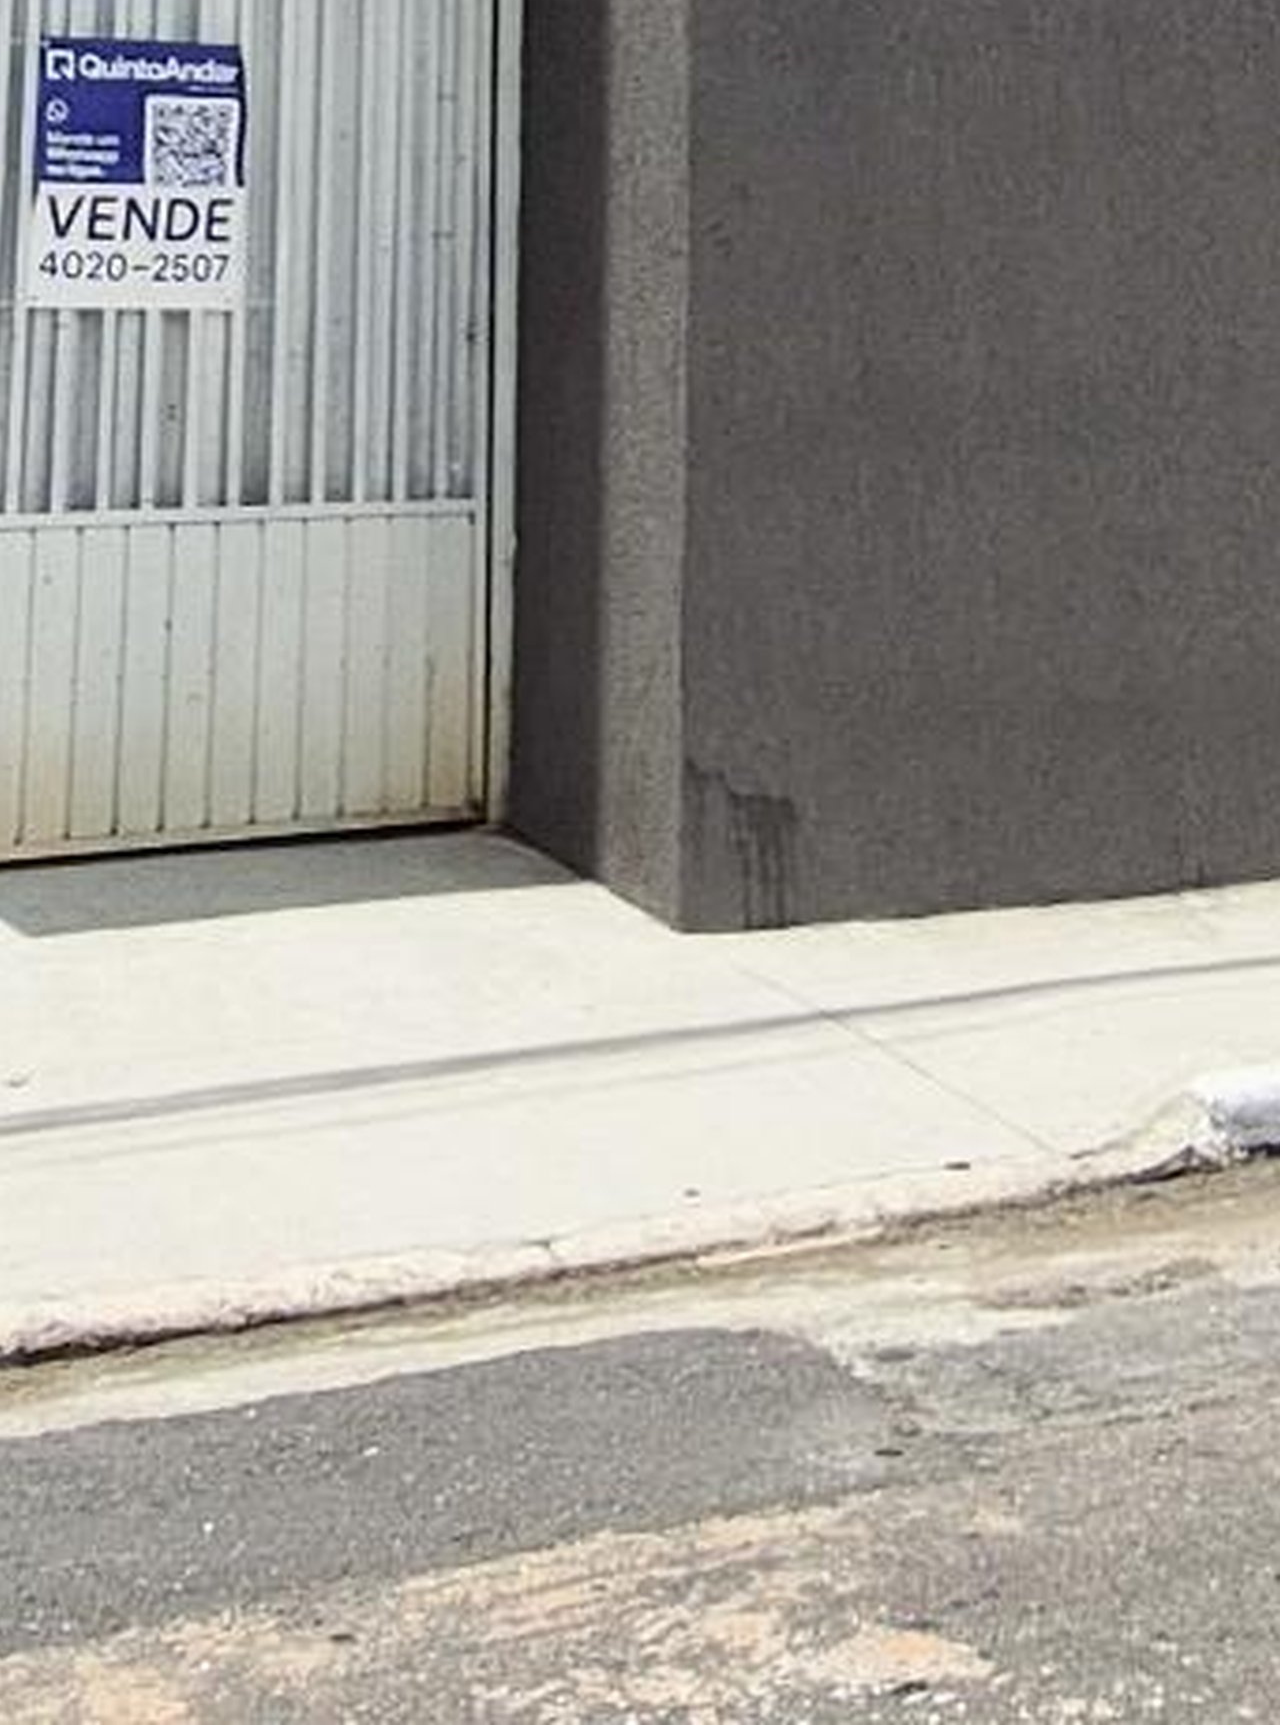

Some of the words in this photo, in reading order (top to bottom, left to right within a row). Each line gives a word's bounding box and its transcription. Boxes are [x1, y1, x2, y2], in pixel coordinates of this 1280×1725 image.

[79, 53, 239, 83] QuintoAndar
[48, 195, 233, 242] VENDE
[39, 250, 230, 282] 4020-2507
